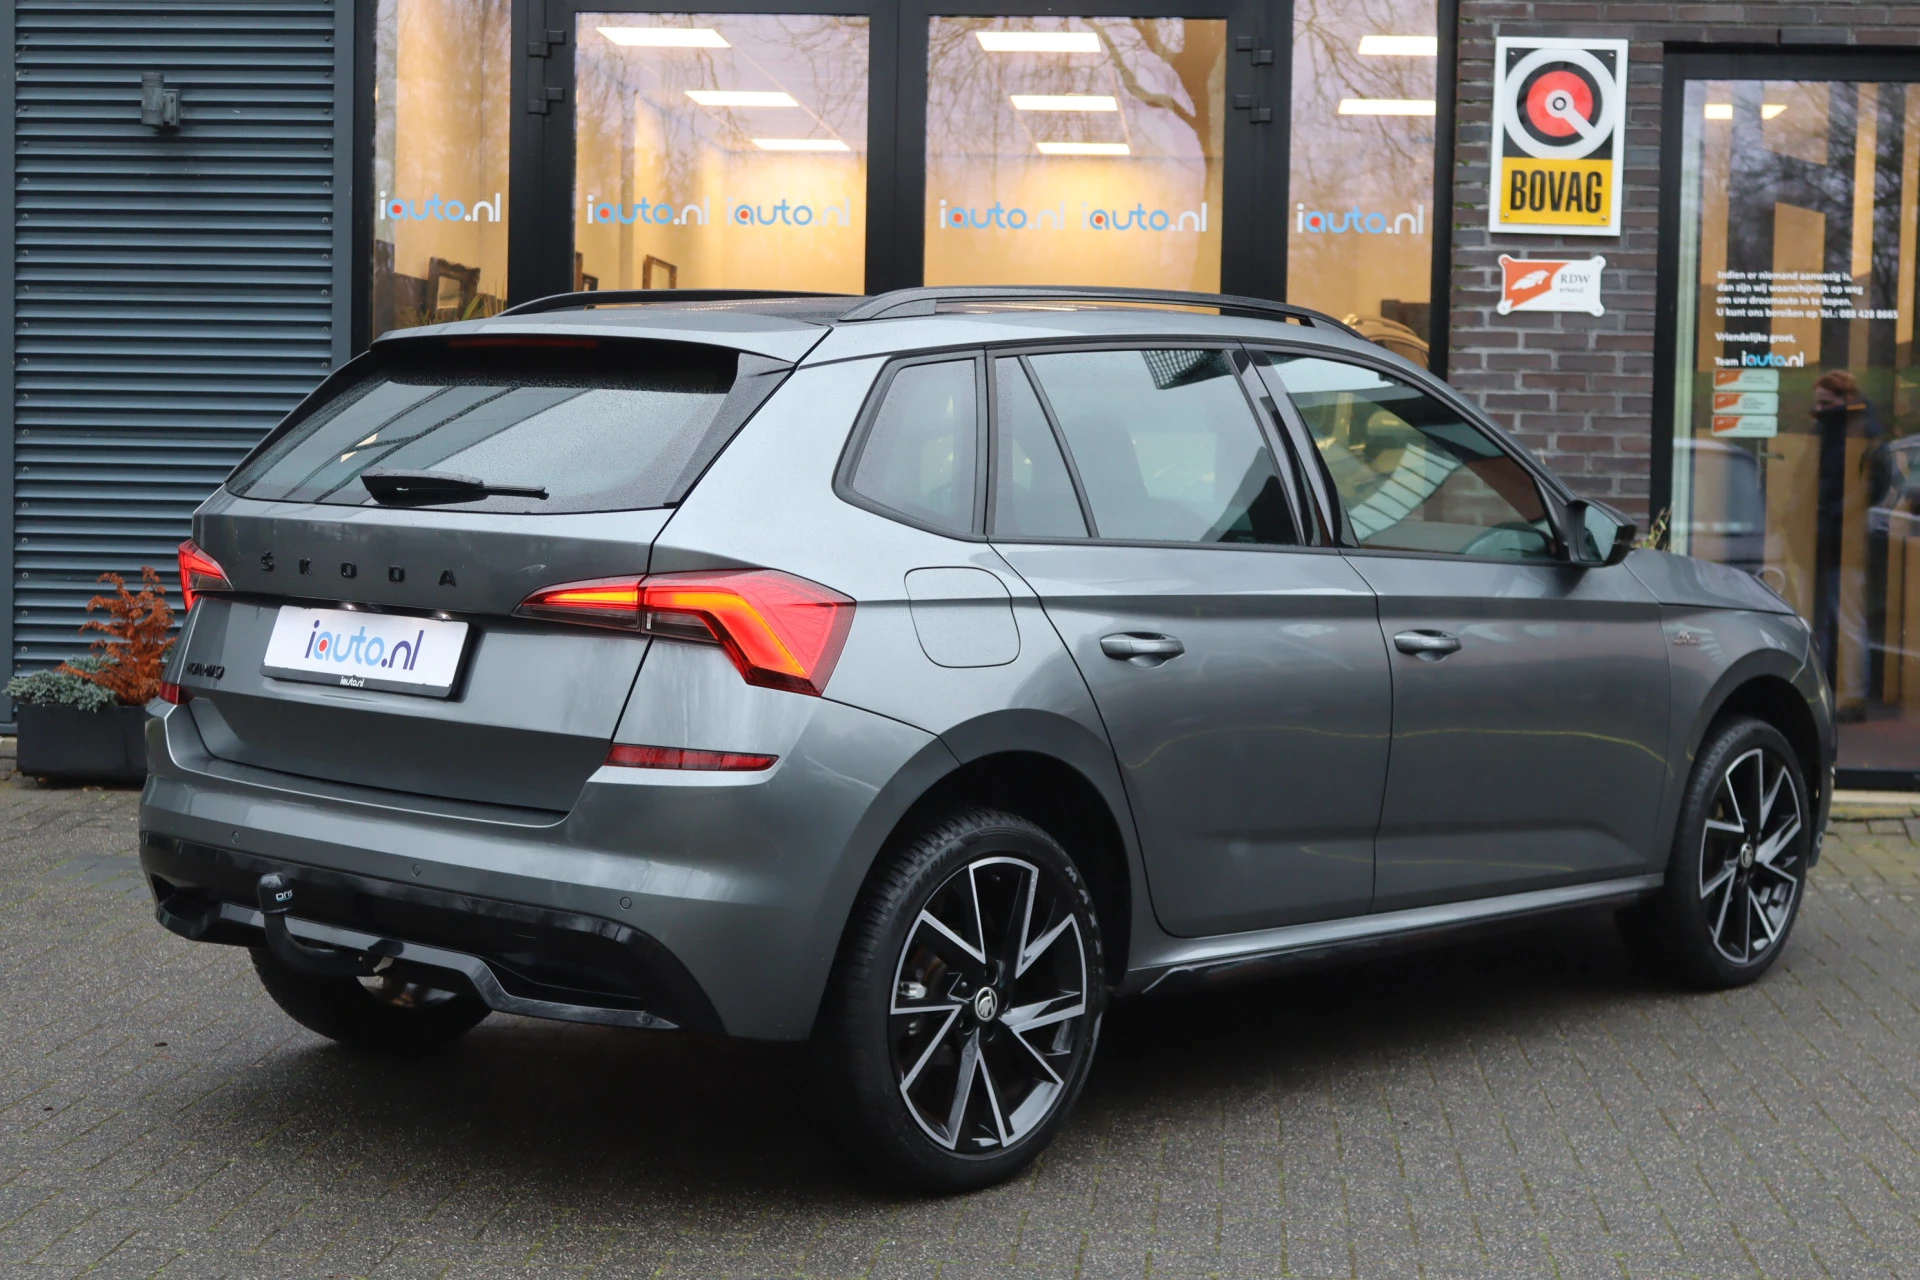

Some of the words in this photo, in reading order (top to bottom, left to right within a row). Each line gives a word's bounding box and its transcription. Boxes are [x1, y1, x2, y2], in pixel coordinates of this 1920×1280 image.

[378, 190, 502, 222] iauto.nl
[1509, 169, 1603, 214] BOVAG
[587, 194, 710, 225] iauto.nl
[726, 196, 851, 227] iauto.nl
[938, 199, 1066, 231] iauto.nl
[1080, 201, 1208, 232] iauto.nl
[1296, 202, 1425, 235] iauto.nl
[1560, 273, 1592, 284] RDW
[1716, 270, 1746, 280] Indien
[1747, 271, 1758, 280] er
[1758, 270, 1798, 281] niemand
[1799, 272, 1841, 283] aanwezig
[1716, 283, 1735, 292] dan
[1735, 283, 1752, 293] zijn
[1753, 283, 1768, 294] wij
[1768, 284, 1829, 295] waarschijnlijk
[1830, 285, 1843, 295] op
[1844, 286, 1864, 296] weg
[1716, 296, 1732, 305] om
[1733, 296, 1748, 305] uw
[1748, 295, 1799, 305] droomauto
[1801, 296, 1810, 306] in
[1810, 297, 1820, 306] te
[1716, 308, 1724, 317] U
[1725, 308, 1746, 317] kunt
[1747, 309, 1764, 318] ons
[1764, 308, 1804, 318] bereiken
[1805, 310, 1818, 320] op
[1714, 332, 1769, 344] Vriendelijke
[1714, 356, 1739, 367] Team
[1741, 350, 1805, 368] iauto.nl
[304, 619, 425, 672] iauto.nl
